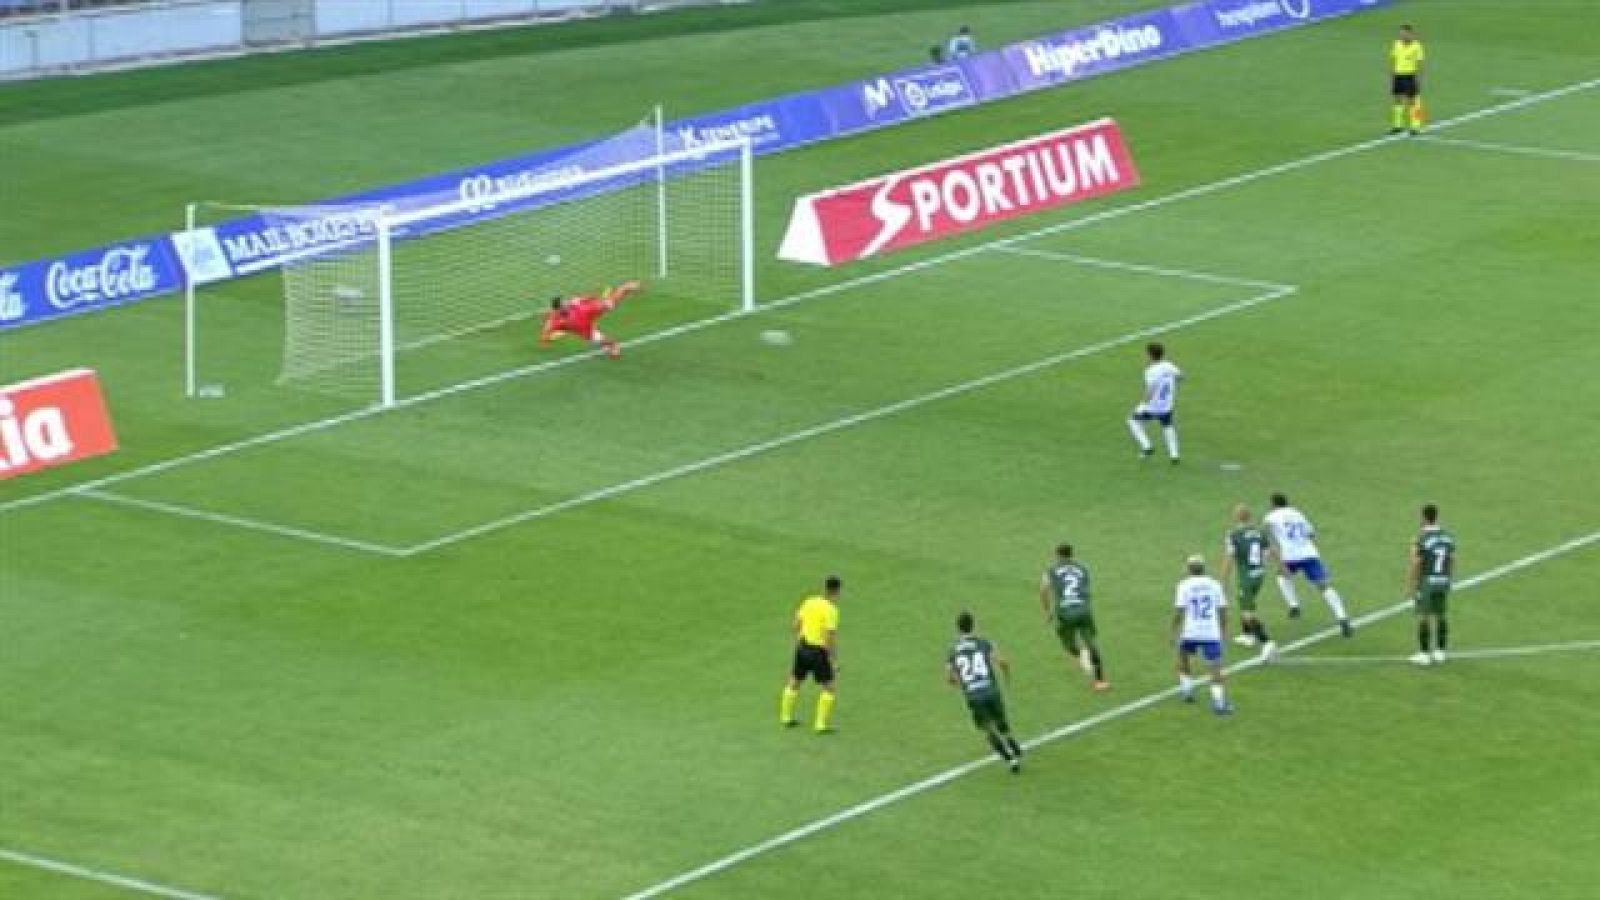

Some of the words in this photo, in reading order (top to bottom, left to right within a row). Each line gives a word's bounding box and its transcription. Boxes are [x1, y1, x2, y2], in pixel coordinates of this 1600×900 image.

[857, 134, 1120, 259] SPORTIUM
[0, 397, 76, 469] ia
[1062, 574, 1082, 596] 2
[1190, 594, 1213, 620] 12
[955, 651, 989, 681] 24
